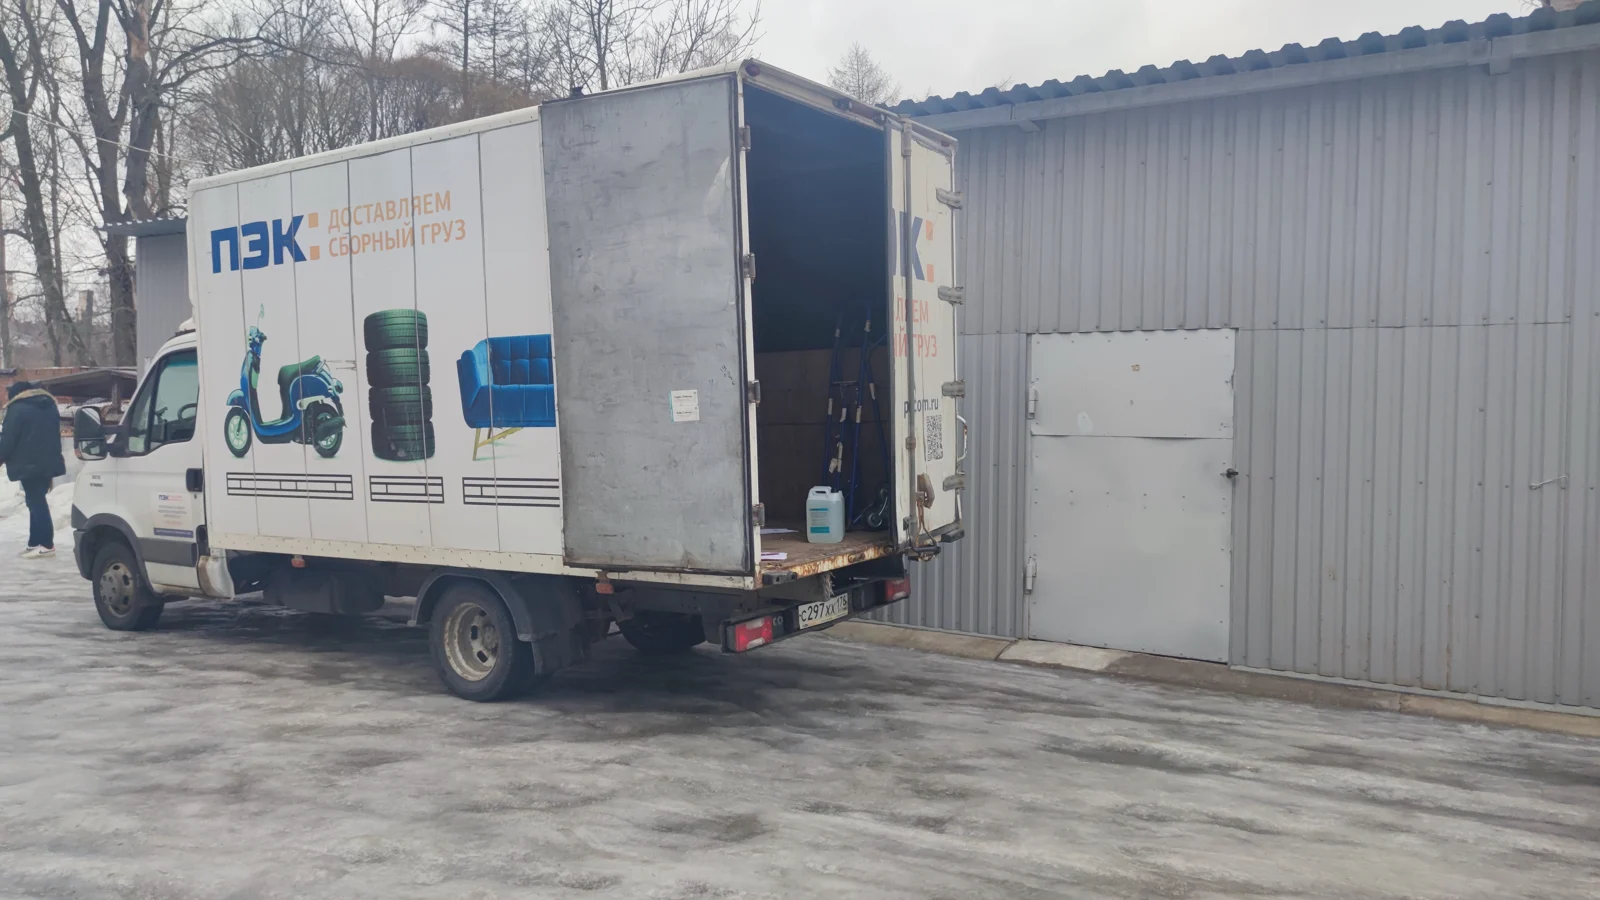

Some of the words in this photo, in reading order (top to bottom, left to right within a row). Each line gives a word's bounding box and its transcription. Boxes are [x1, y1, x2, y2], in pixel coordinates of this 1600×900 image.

[328, 191, 451, 233] ДОСТАВЛЯЕМ
[328, 221, 414, 258] СБОРНЫЙ
[420, 218, 467, 246] ГРУЗ
